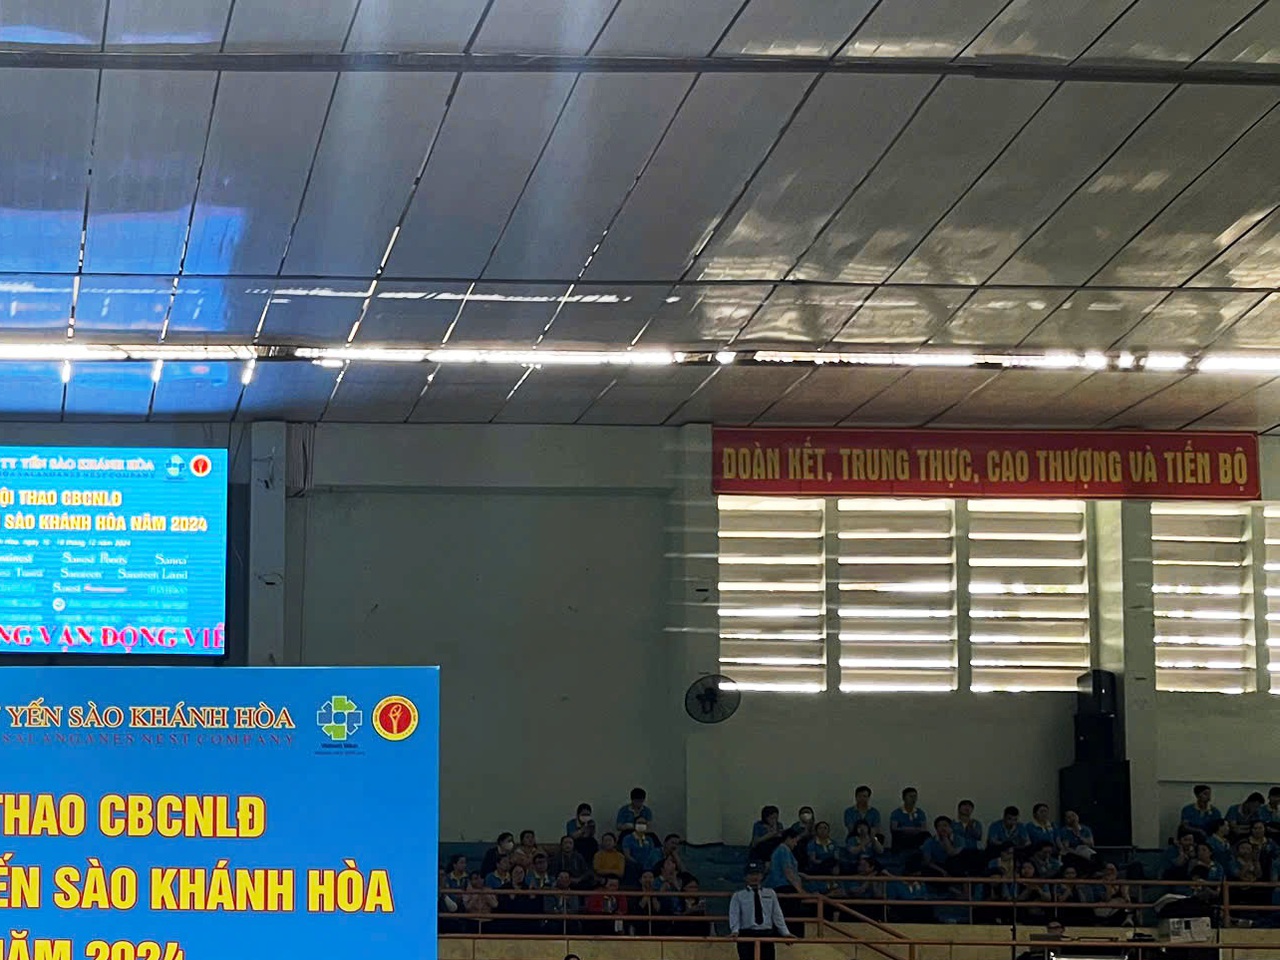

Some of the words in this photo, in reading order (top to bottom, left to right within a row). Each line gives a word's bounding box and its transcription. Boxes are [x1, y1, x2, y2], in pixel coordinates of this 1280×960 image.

[722, 442, 782, 481] ĐOÀN
[787, 437, 833, 483] KẾT,
[839, 448, 910, 482] TRUNG
[917, 448, 980, 489] THỰC,
[986, 448, 1029, 483] CAO
[1036, 450, 1122, 489] THƯỢNG
[1129, 445, 1158, 483] VÀ
[1164, 441, 1211, 484] TIẾN
[1218, 446, 1248, 492] BỘ
[18, 489, 58, 507] THAO
[5, 511, 36, 530] SÀO
[39, 511, 93, 531] KHÁNH
[95, 511, 127, 531] HÒA
[130, 512, 167, 531] NĂM
[170, 516, 208, 532] 2024
[4, 697, 64, 729] YẾN
[68, 700, 124, 729] SÀO
[128, 701, 229, 729] KHÁNH
[233, 701, 296, 730] HÒA
[98, 793, 269, 839] CBCNLĐ
[52, 859, 140, 912] SÀO
[149, 859, 296, 914] KHÁNH
[306, 860, 397, 914] HÒA
